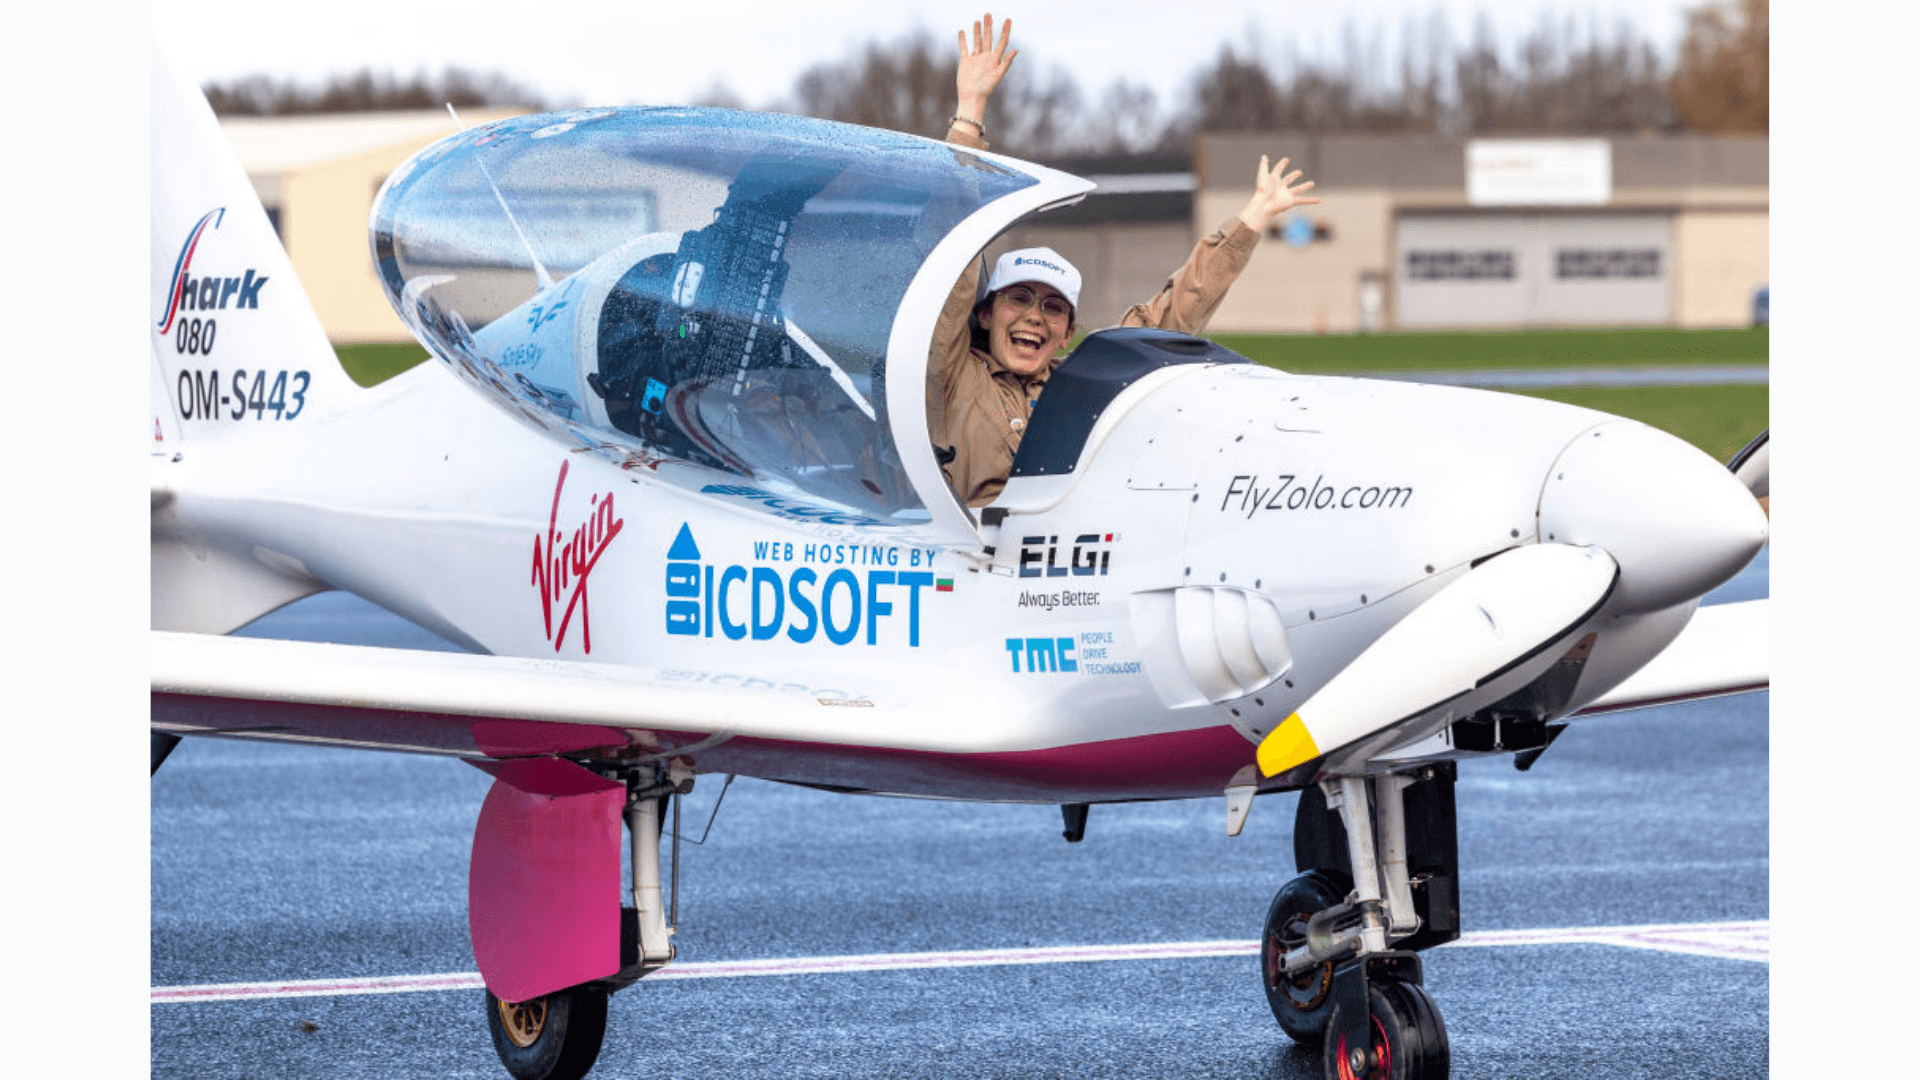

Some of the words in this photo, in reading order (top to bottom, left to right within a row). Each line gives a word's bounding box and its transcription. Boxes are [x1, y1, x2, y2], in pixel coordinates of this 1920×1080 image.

[176, 317, 216, 356] 080
[178, 369, 311, 421] OM-S443
[1220, 474, 1414, 519] FlyZolo.com
[531, 459, 624, 655] Virgin
[754, 540, 794, 562] WEB
[804, 543, 898, 567] HOSTING
[910, 547, 936, 567] BY
[704, 564, 934, 647] ICDSOFT
[1018, 589, 1060, 611] Always
[1062, 590, 1100, 607] Better.
[1005, 637, 1078, 673] TMC
[1081, 631, 1113, 644] PEOPLE
[1082, 647, 1108, 660] DRIVE
[1084, 661, 1141, 676] TECHNOLOGY
